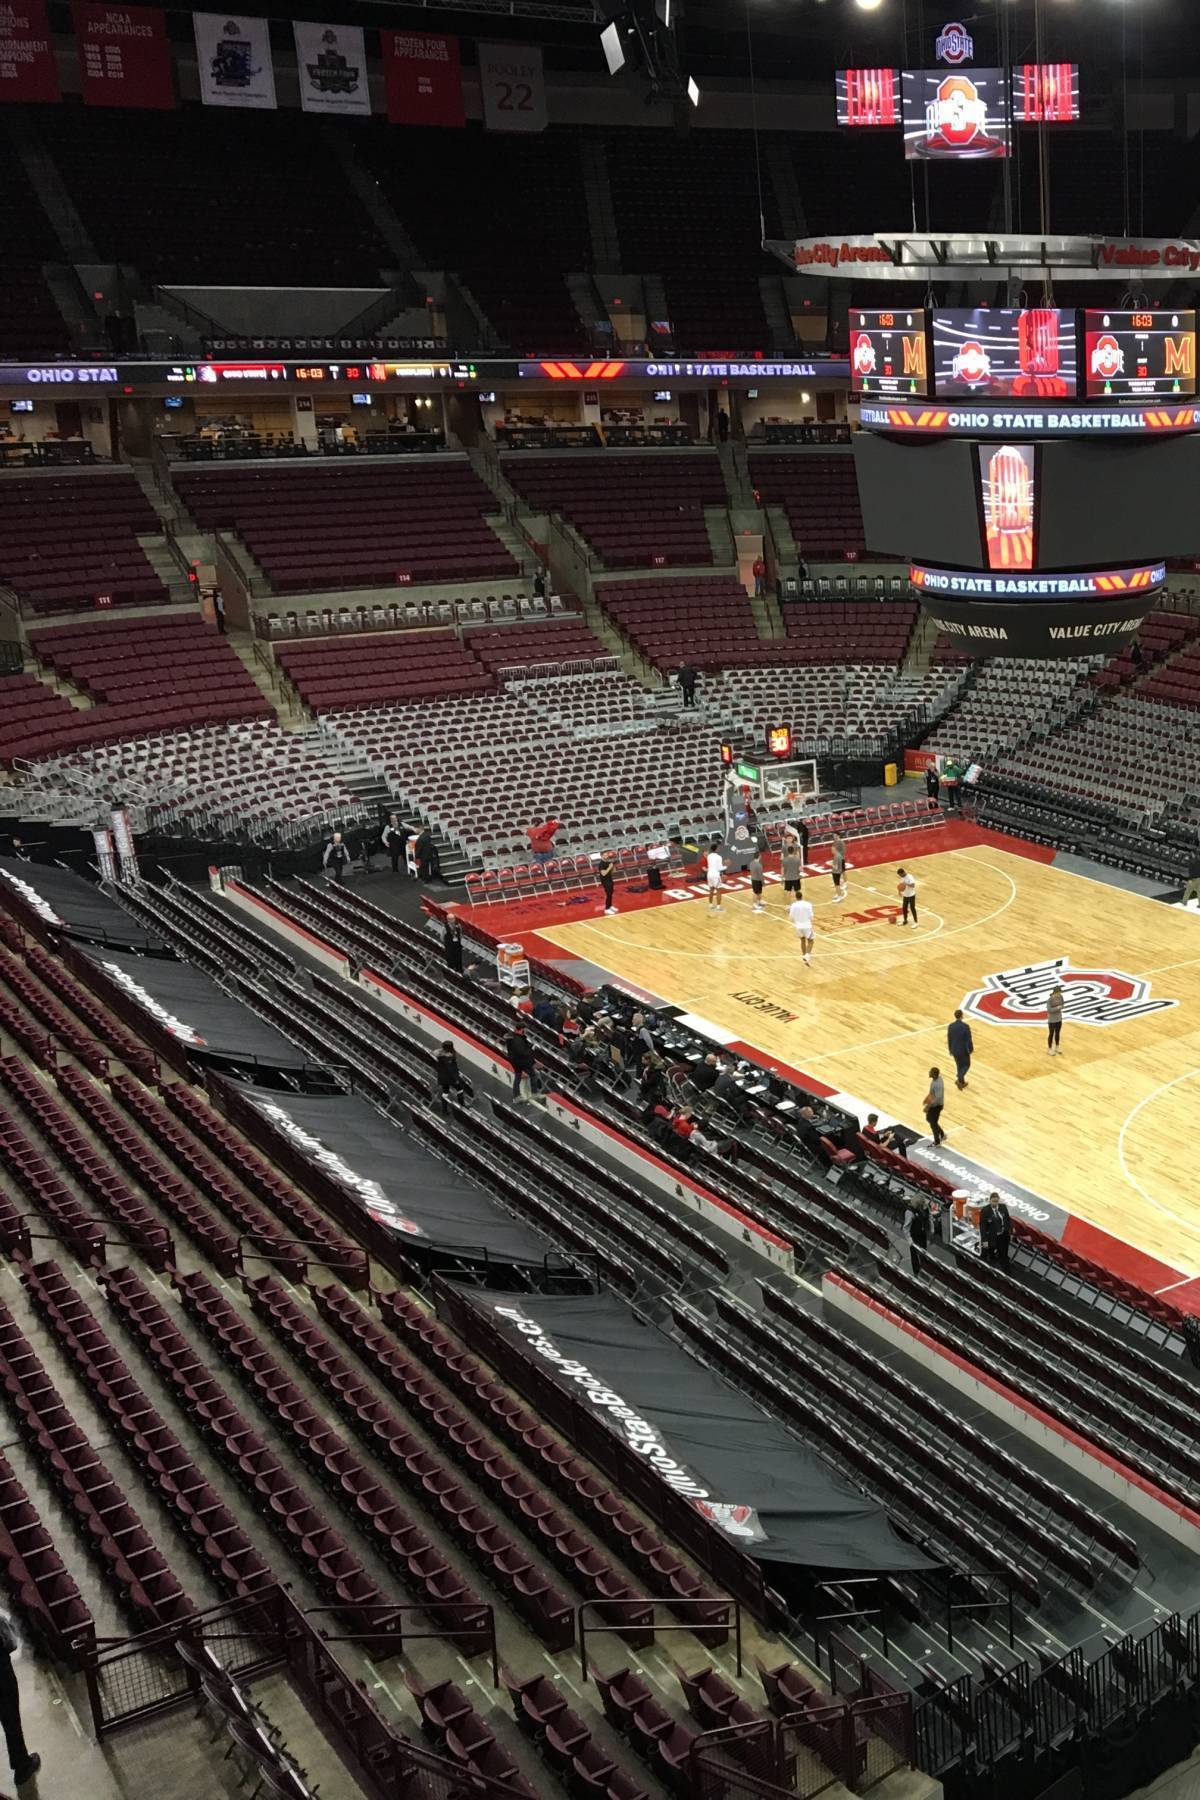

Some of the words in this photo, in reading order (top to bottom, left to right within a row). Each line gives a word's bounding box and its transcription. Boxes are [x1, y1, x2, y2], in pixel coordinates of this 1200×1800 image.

[105, 12, 131, 24] NCAA
[88, 21, 153, 37] APPEARANCES
[394, 36, 424, 49] FROZEN
[394, 49, 449, 61] APPEARANCES
[496, 82, 535, 111] 22
[1100, 244, 1160, 264] Value
[1162, 246, 1199, 271] City
[1165, 337, 1191, 374] M
[27, 369, 74, 382] OHIO
[295, 368, 324, 378] 16:03
[347, 368, 360, 378] 30
[730, 365, 816, 376] BASKETBALL
[948, 412, 989, 428] OHIO
[992, 413, 1041, 428] STATE
[1047, 413, 1146, 429] BASKETBALL
[924, 574, 949, 589] OHIO
[951, 576, 993, 592] STATE
[996, 578, 1097, 594] BASKETBALL
[98, 596, 110, 604] 111
[967, 623, 1008, 640] ARENA
[1049, 624, 1090, 640] VALUE
[1093, 621, 1121, 637] CITY
[728, 990, 765, 1010] CITY
[760, 1002, 800, 1024] VALUE
